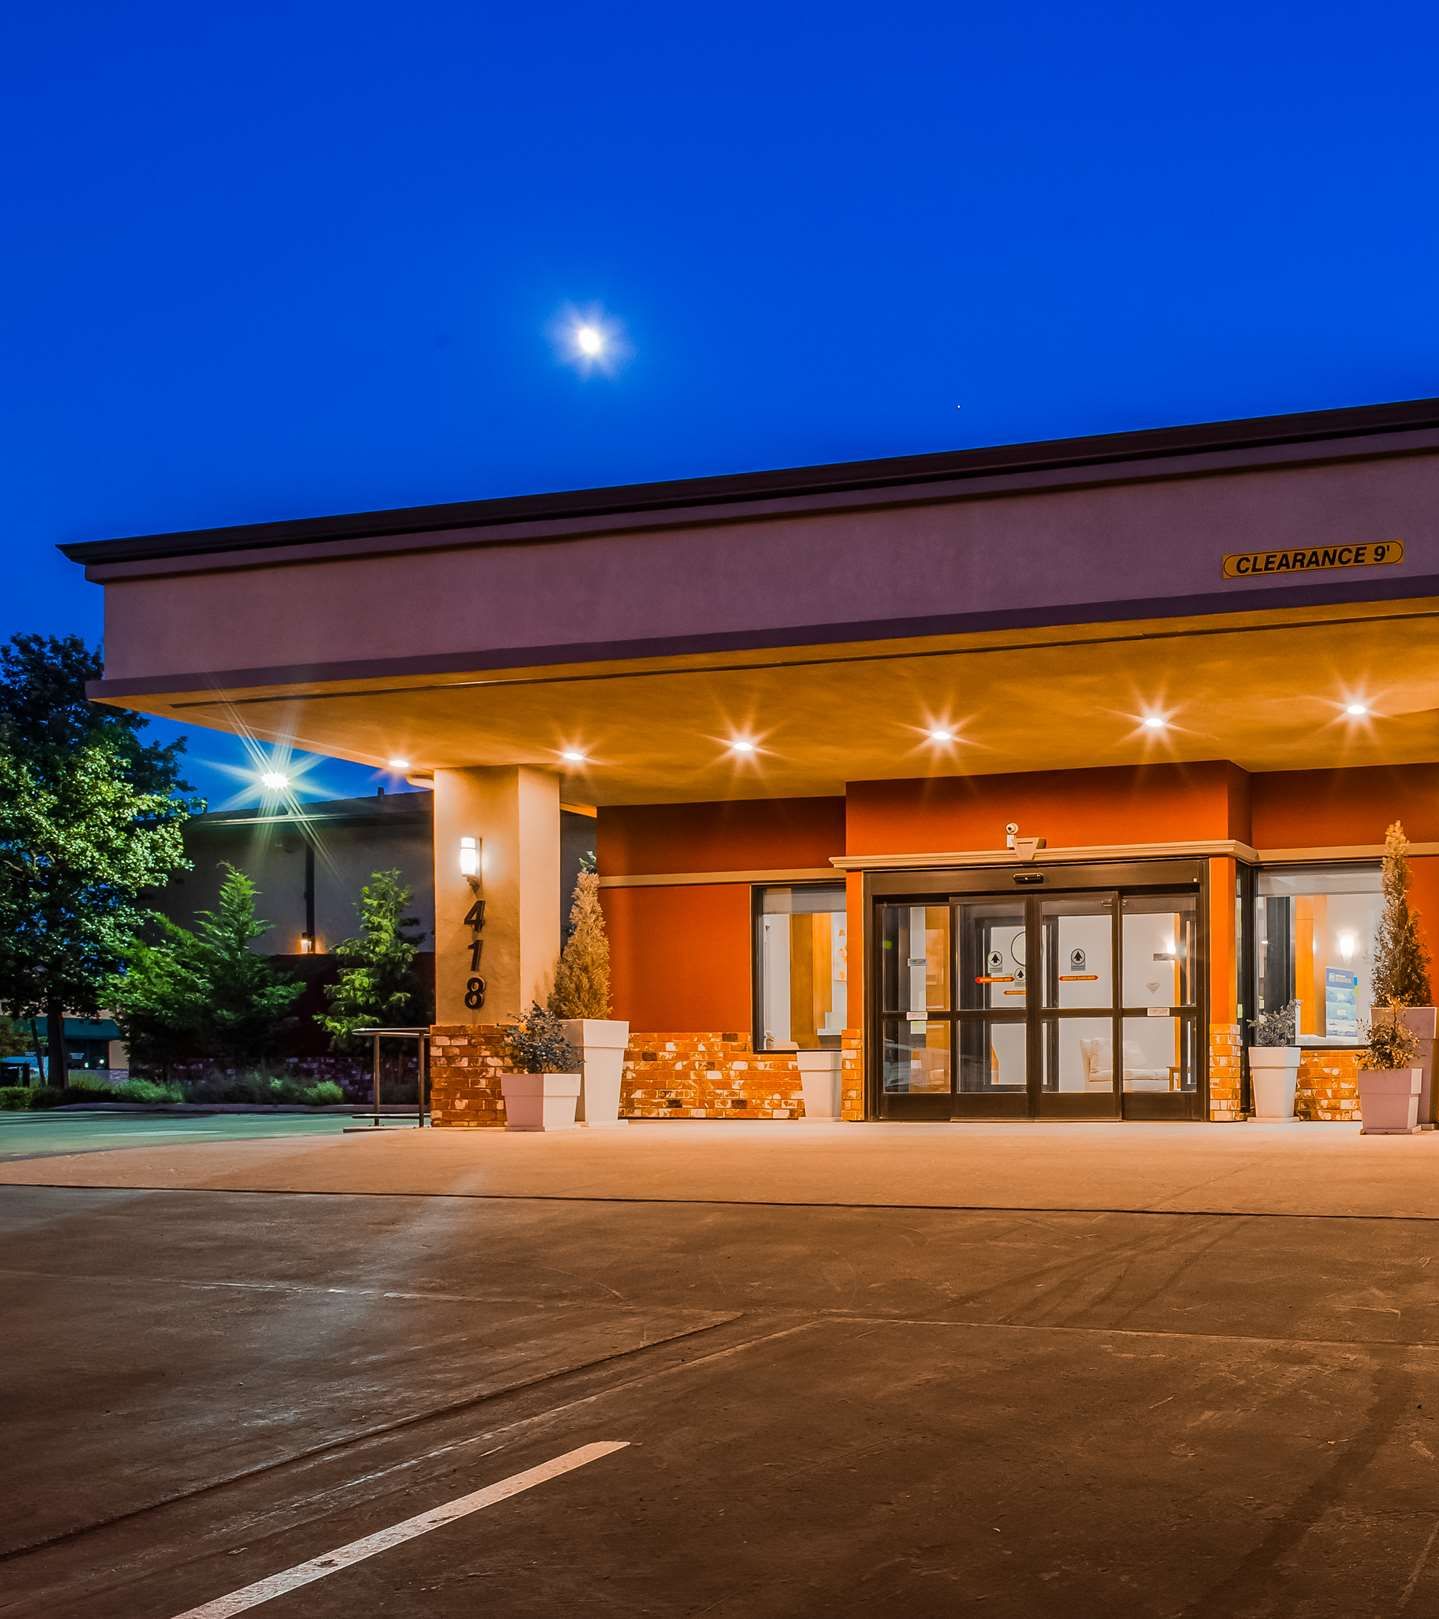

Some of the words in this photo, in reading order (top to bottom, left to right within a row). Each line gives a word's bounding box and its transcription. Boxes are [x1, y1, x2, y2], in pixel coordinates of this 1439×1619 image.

[1236, 546, 1368, 574] CLEARANCE
[1373, 544, 1391, 563] 9'
[463, 900, 487, 1010] 418
